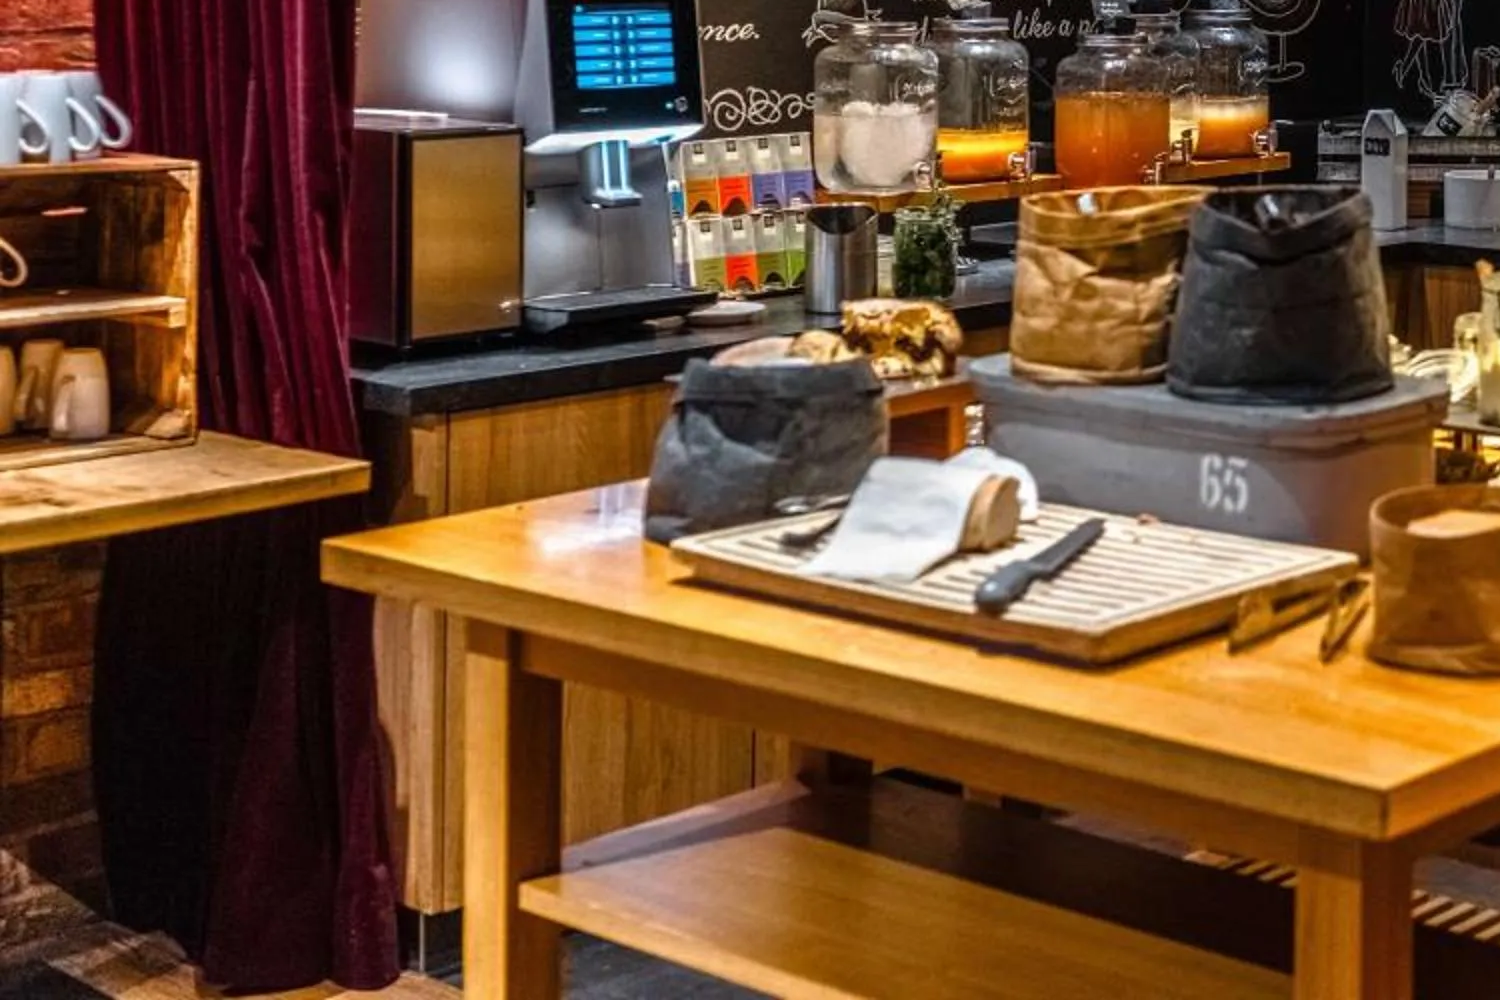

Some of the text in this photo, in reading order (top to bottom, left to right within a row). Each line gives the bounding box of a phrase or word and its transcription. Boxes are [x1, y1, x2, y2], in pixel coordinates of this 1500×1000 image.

[1013, 8, 1056, 39] like
[1059, 20, 1074, 35] a
[1200, 452, 1249, 513] 65
